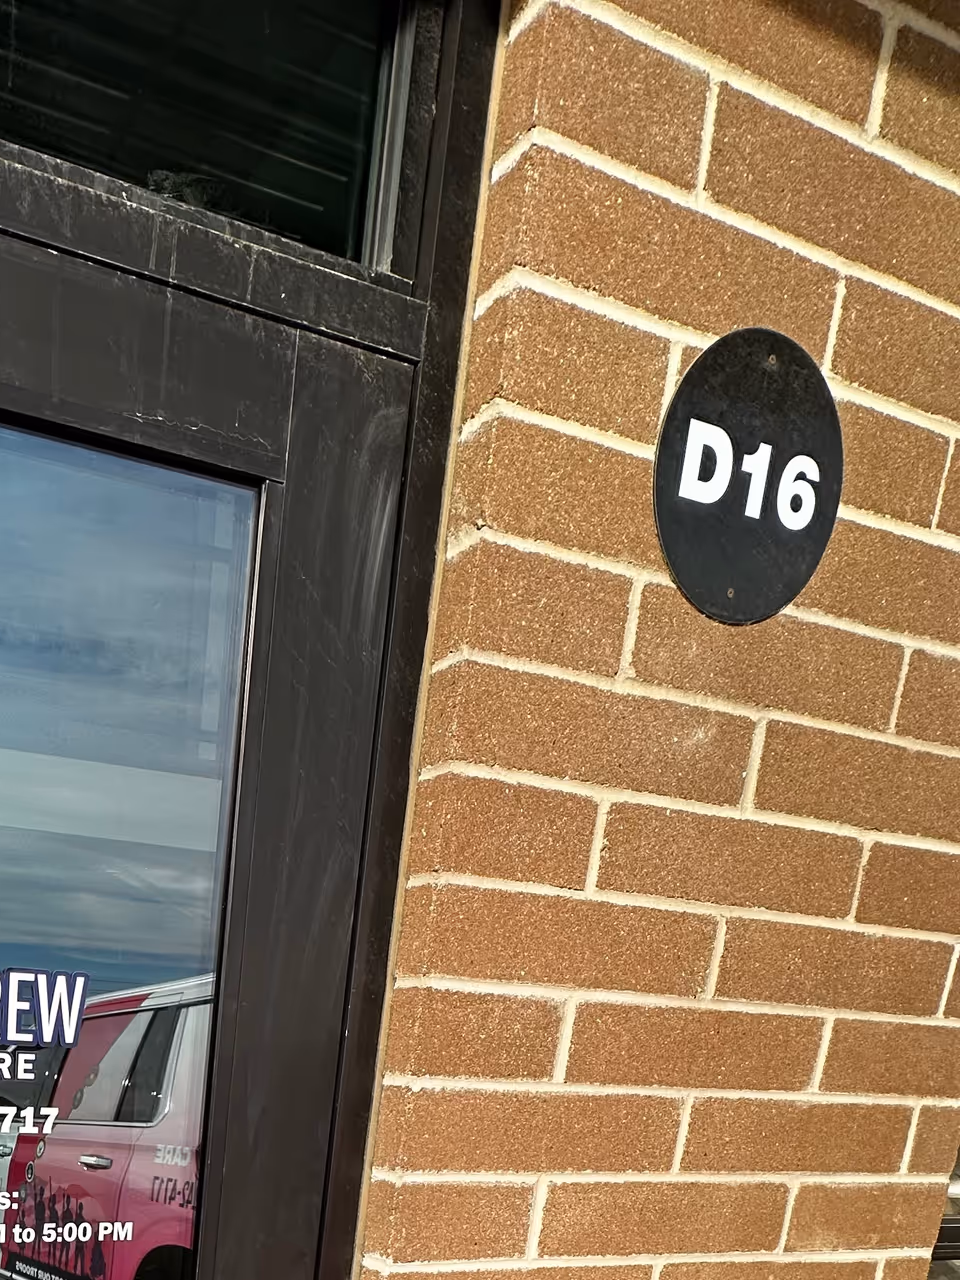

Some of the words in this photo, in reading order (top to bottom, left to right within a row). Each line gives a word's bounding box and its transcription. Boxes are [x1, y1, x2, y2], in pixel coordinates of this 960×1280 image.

[678, 418, 820, 531] D16
[13, 1226, 36, 1243] to
[42, 1223, 92, 1243] 5:00
[98, 1221, 133, 1242] PM
